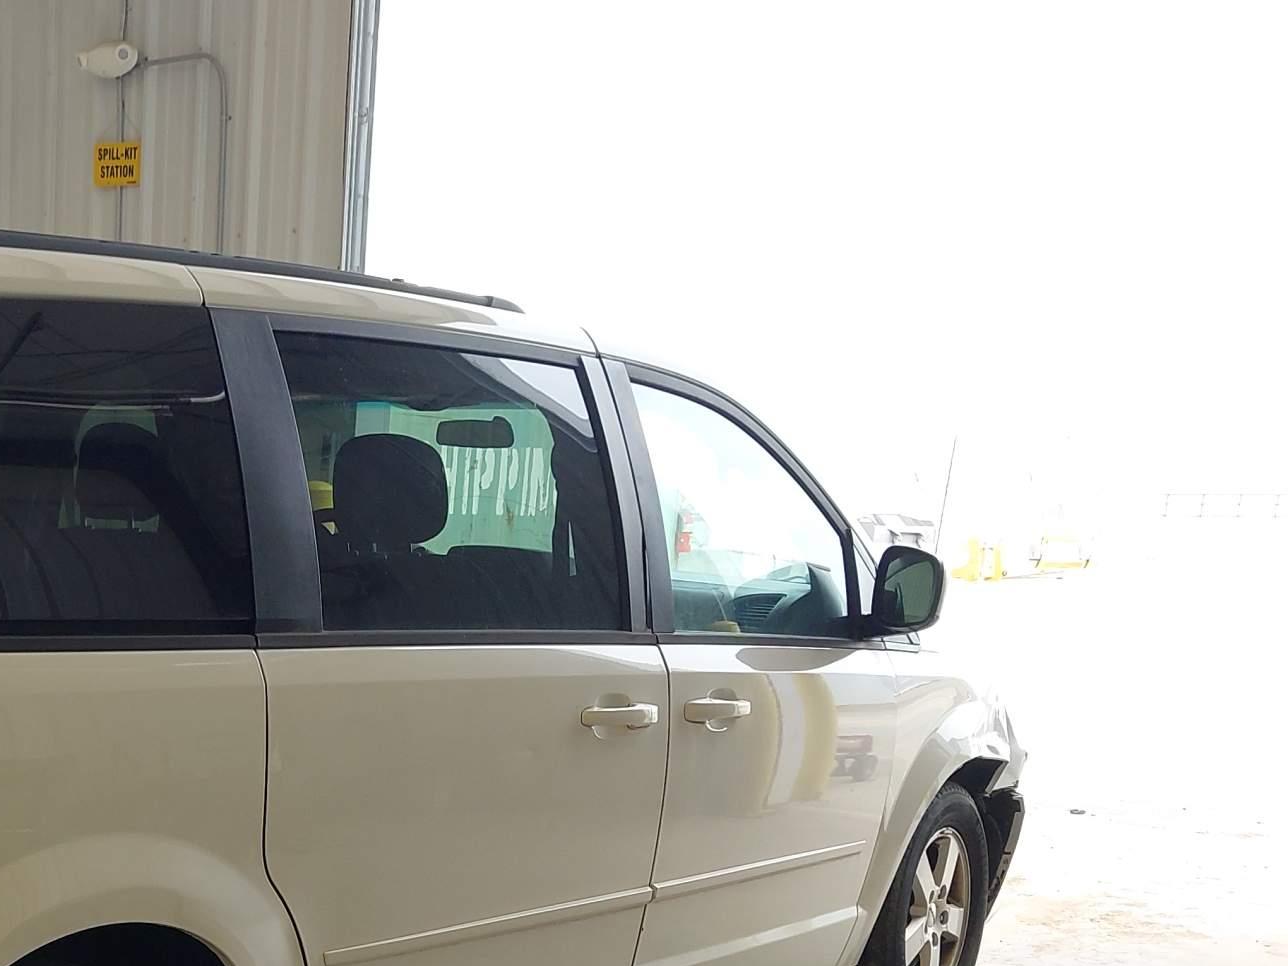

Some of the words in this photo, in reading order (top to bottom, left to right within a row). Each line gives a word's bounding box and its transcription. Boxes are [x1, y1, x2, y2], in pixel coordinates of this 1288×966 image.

[98, 146, 138, 161] SPILL-KIT
[100, 164, 135, 179] STATION
[440, 444, 558, 517] HIPPIN
